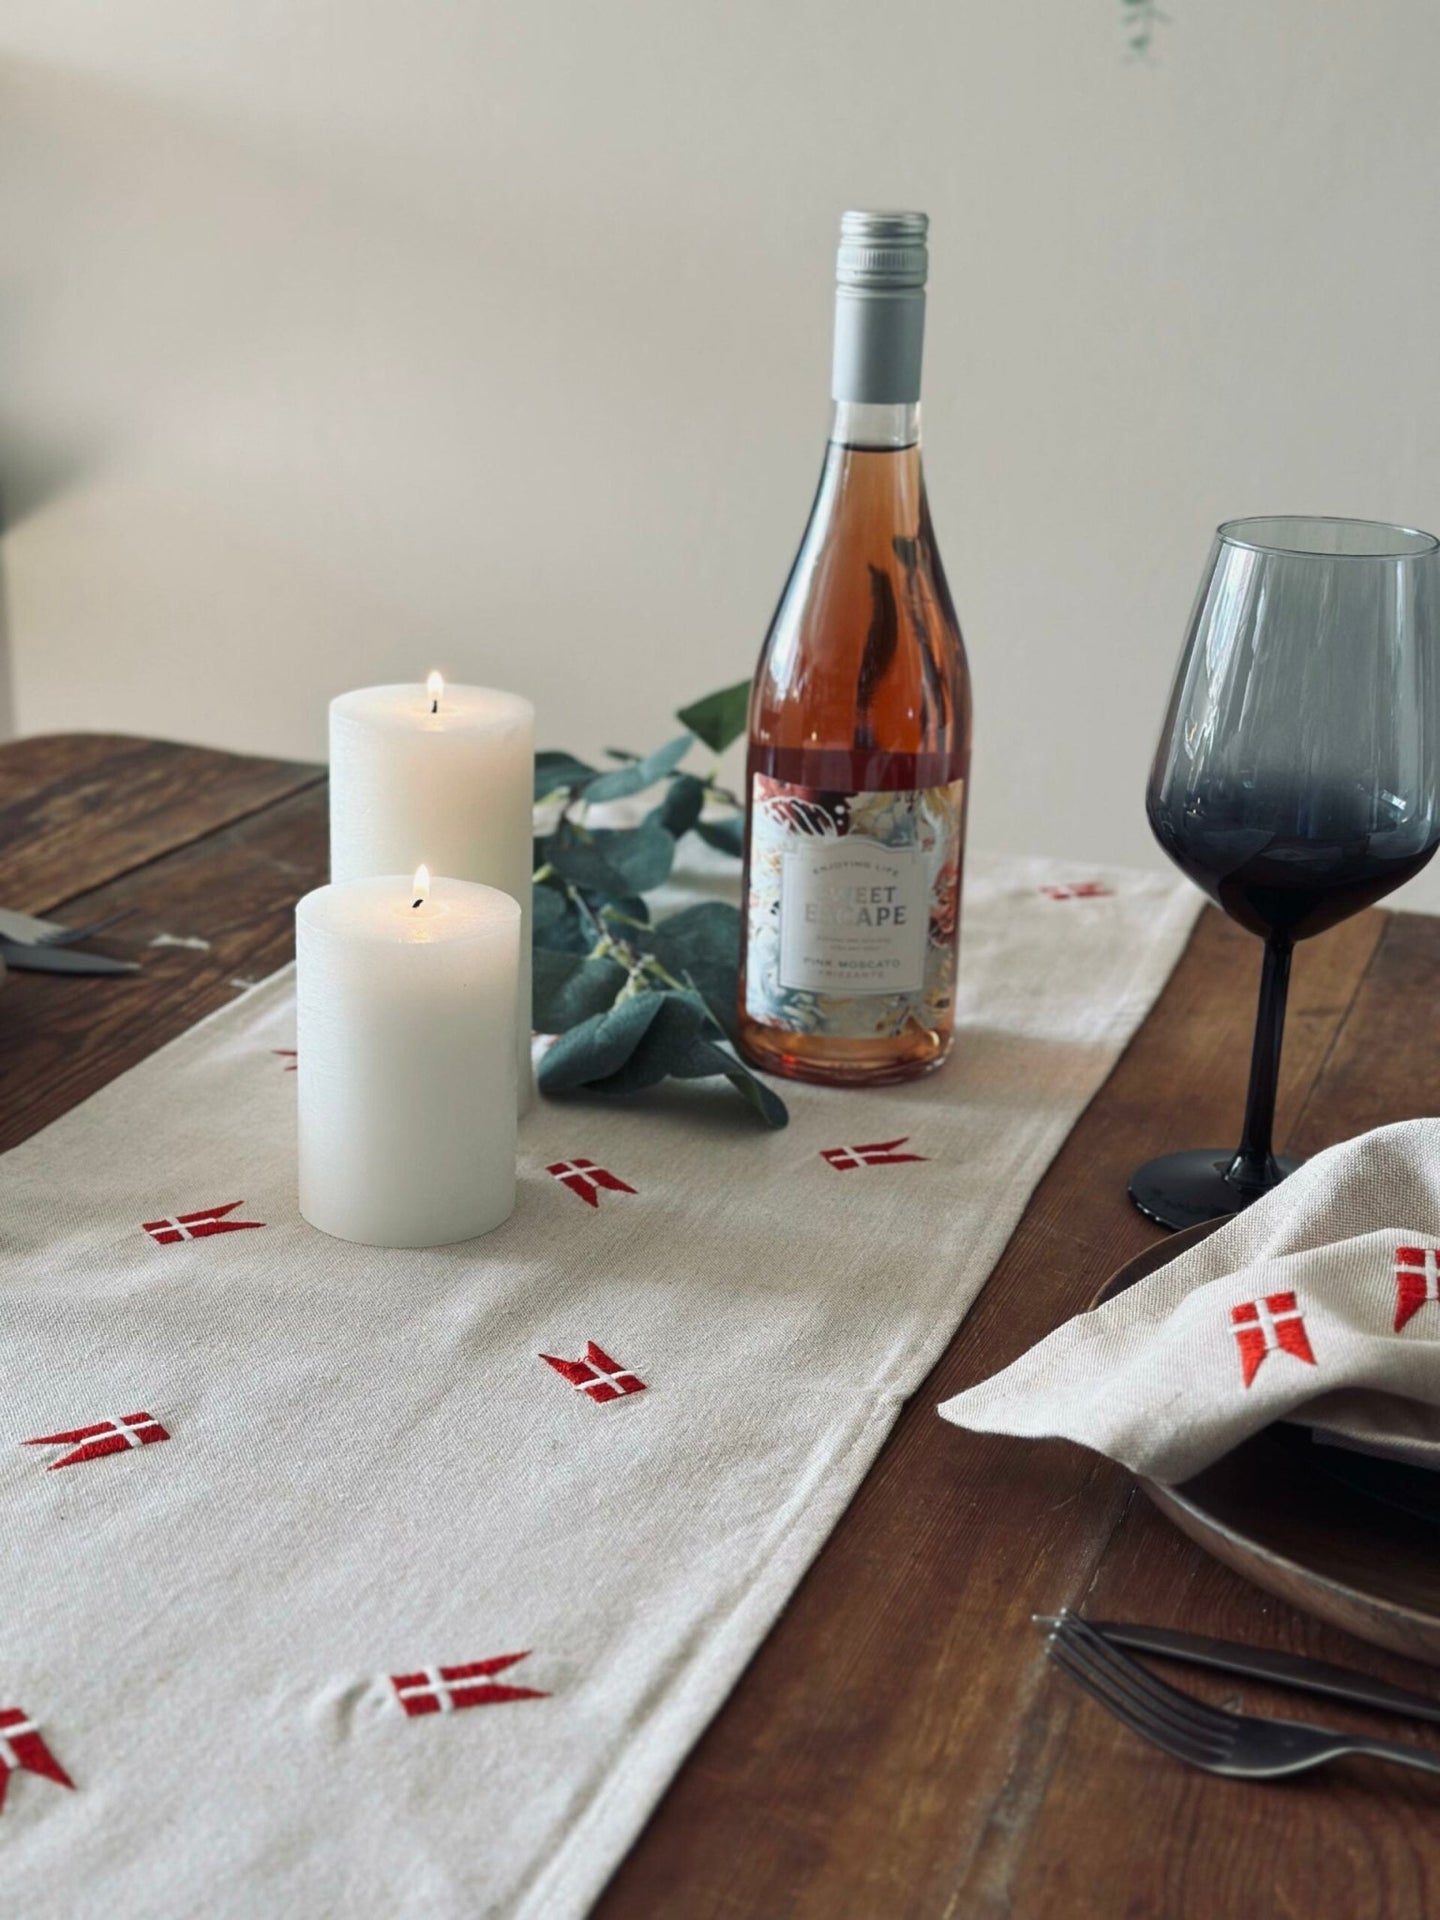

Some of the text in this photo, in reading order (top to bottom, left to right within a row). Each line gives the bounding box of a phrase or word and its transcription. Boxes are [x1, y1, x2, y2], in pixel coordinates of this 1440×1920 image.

[821, 886, 898, 904] WEET
[805, 904, 907, 926] ECAPE
[838, 959, 901, 969] MOSCATO
